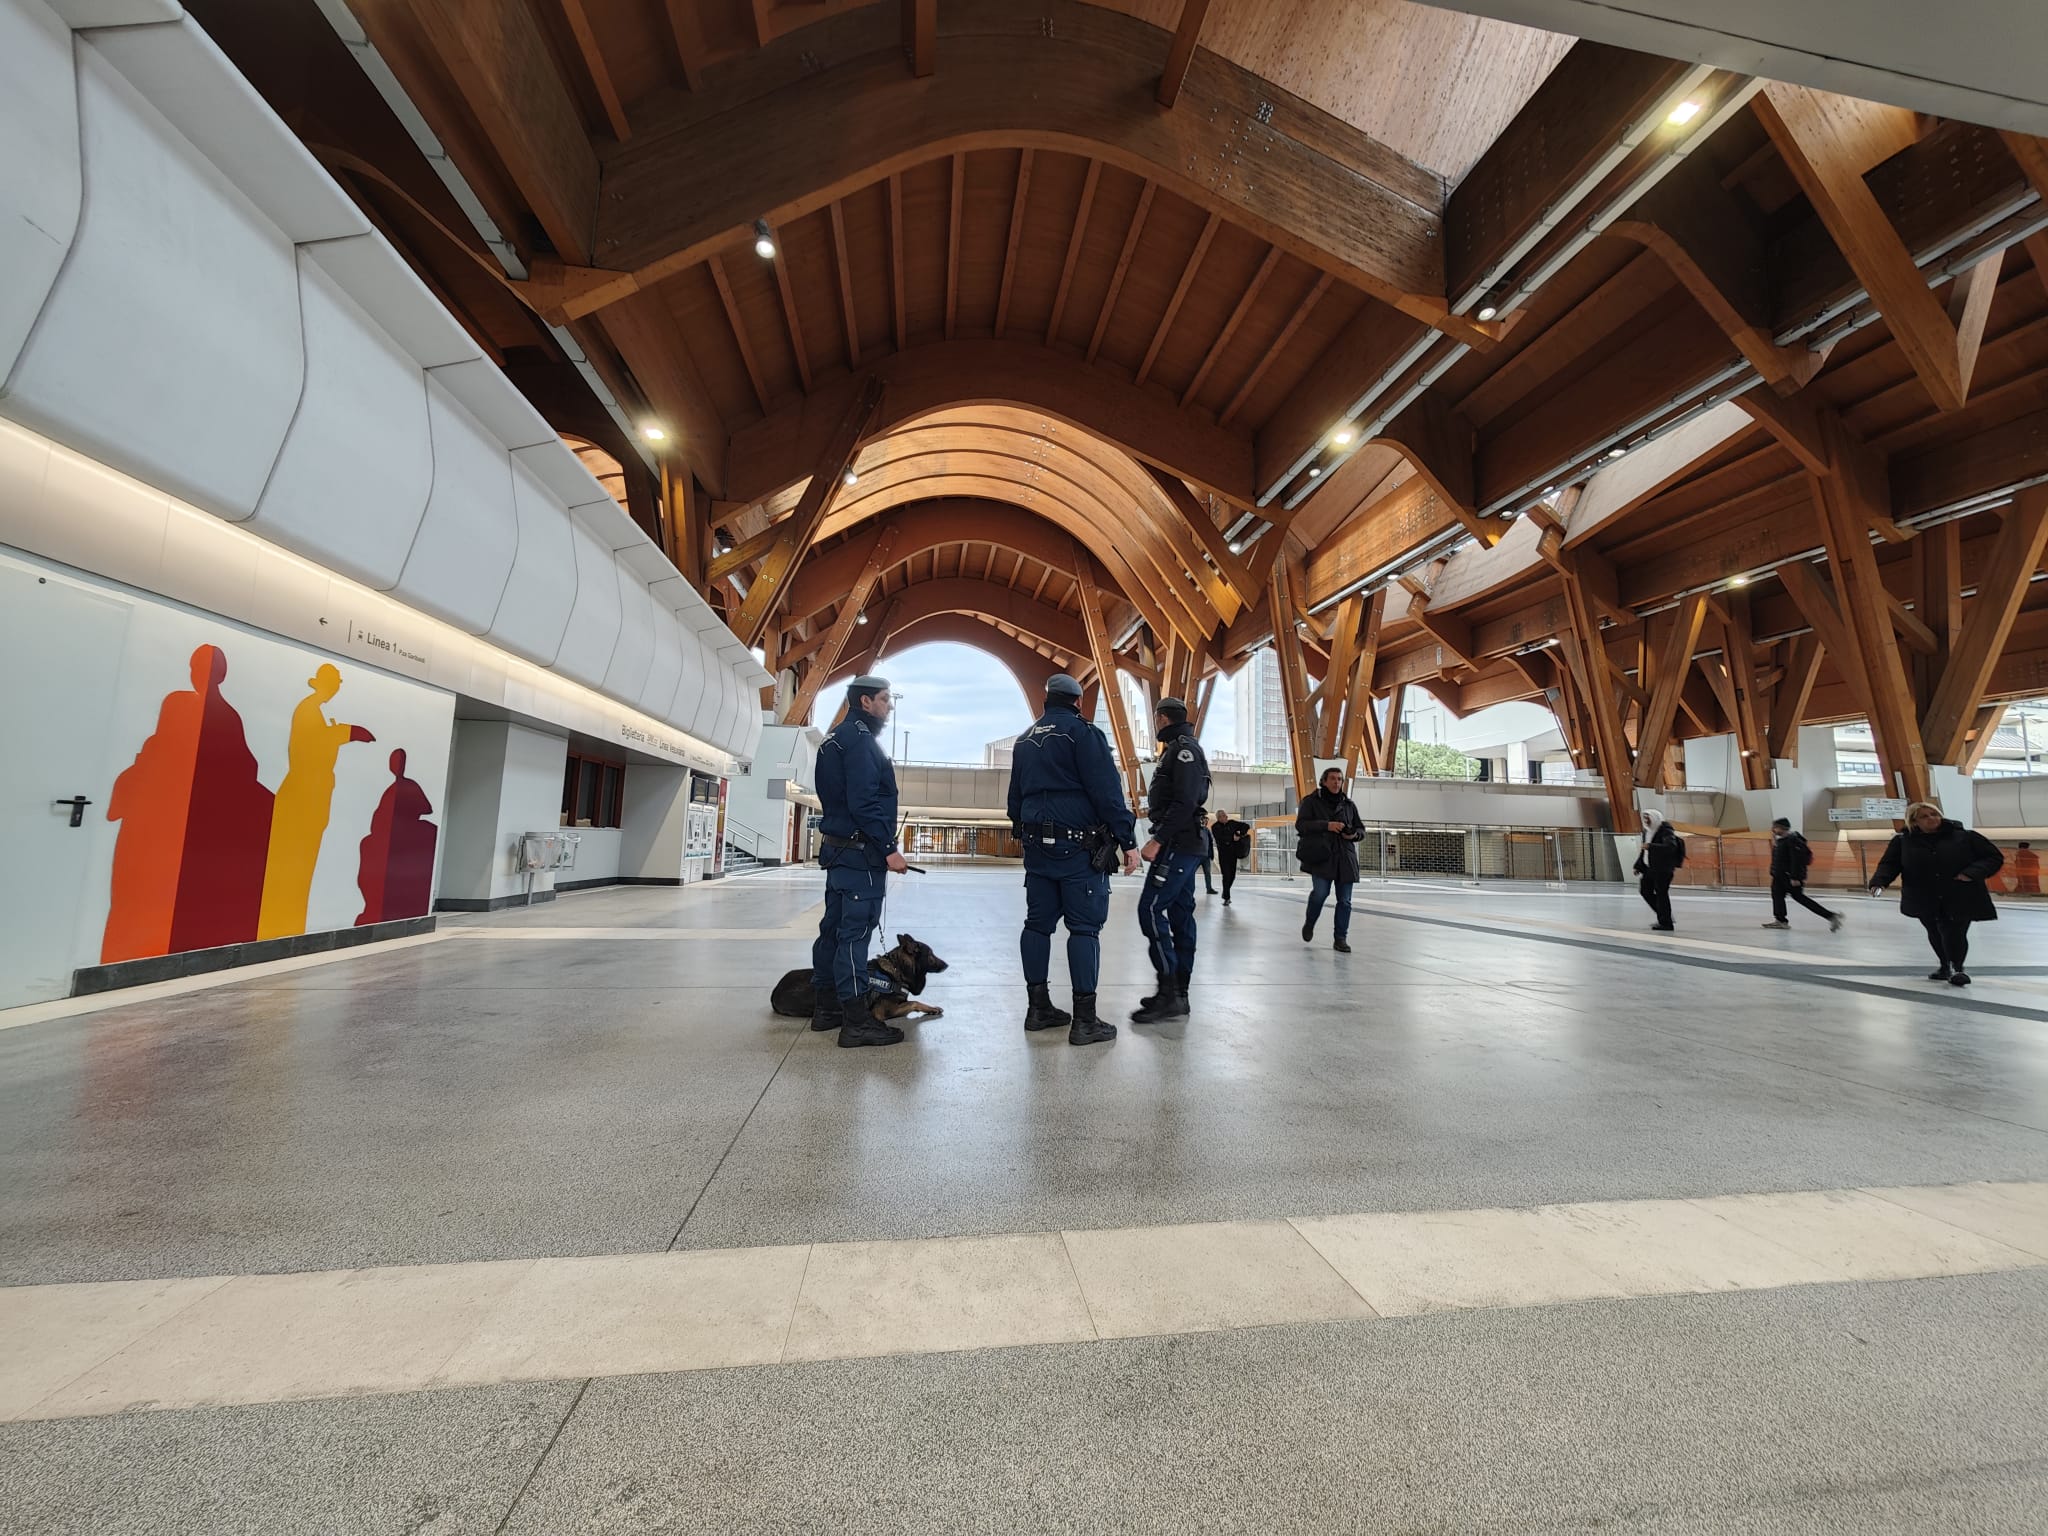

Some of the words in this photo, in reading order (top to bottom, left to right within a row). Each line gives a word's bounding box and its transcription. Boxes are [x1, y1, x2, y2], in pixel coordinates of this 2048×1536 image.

[366, 632, 391, 652] Linea
[392, 642, 398, 653] 1
[868, 976, 891, 989] CURITY
